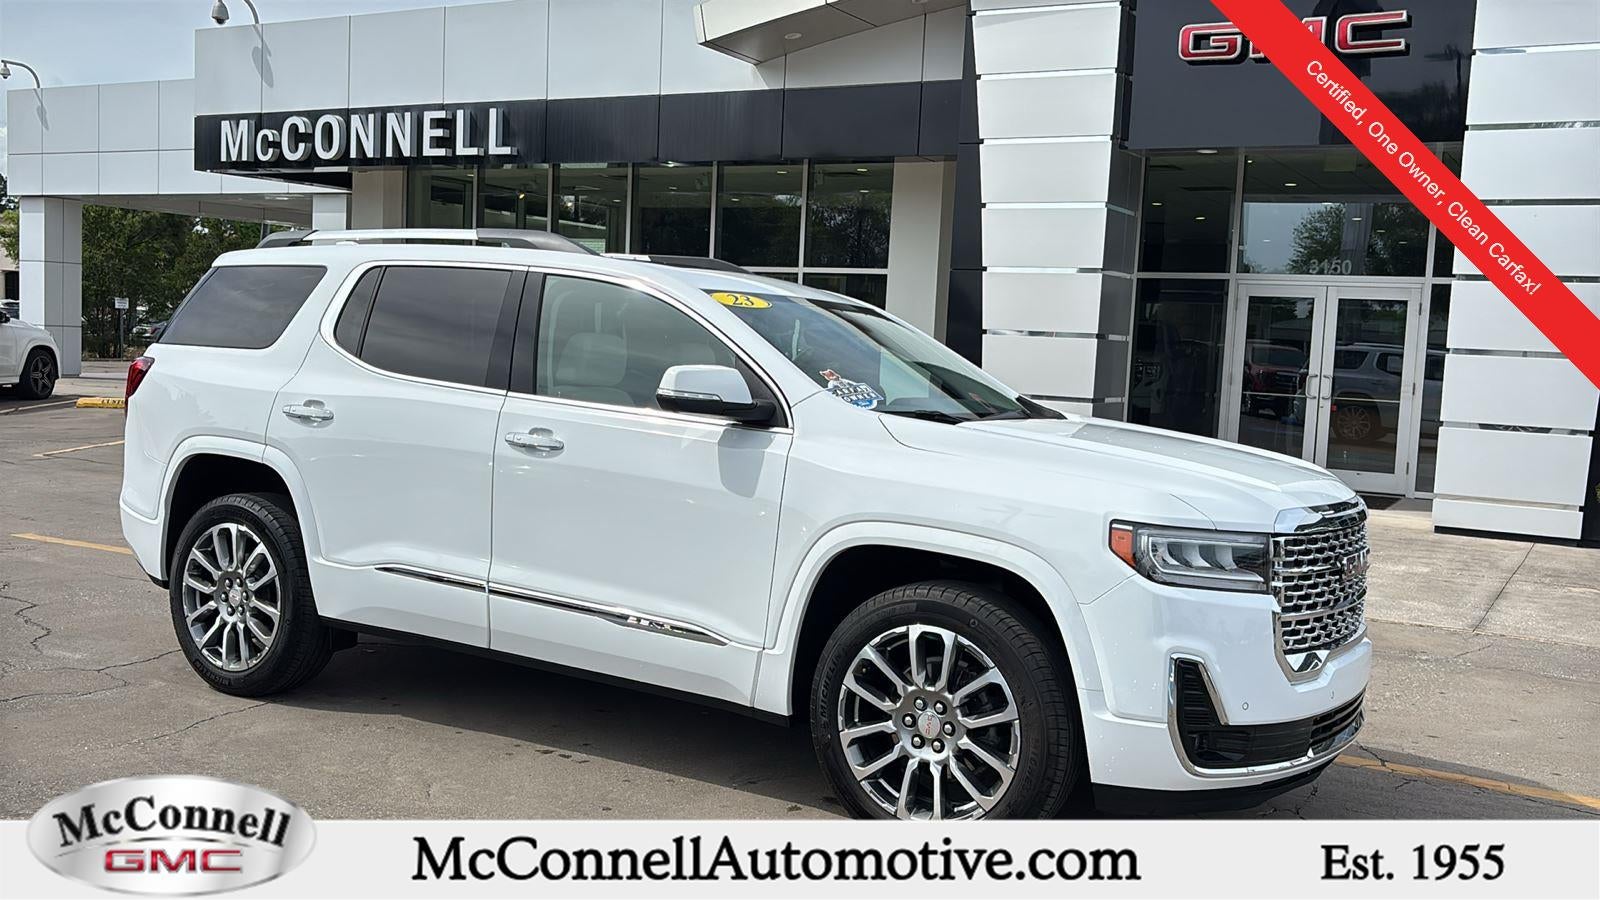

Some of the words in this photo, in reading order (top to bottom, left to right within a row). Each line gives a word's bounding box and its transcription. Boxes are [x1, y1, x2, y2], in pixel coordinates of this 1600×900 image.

[220, 107, 518, 163] McCONNELL
[1309, 259, 1352, 275] 3150
[727, 294, 755, 306] 23
